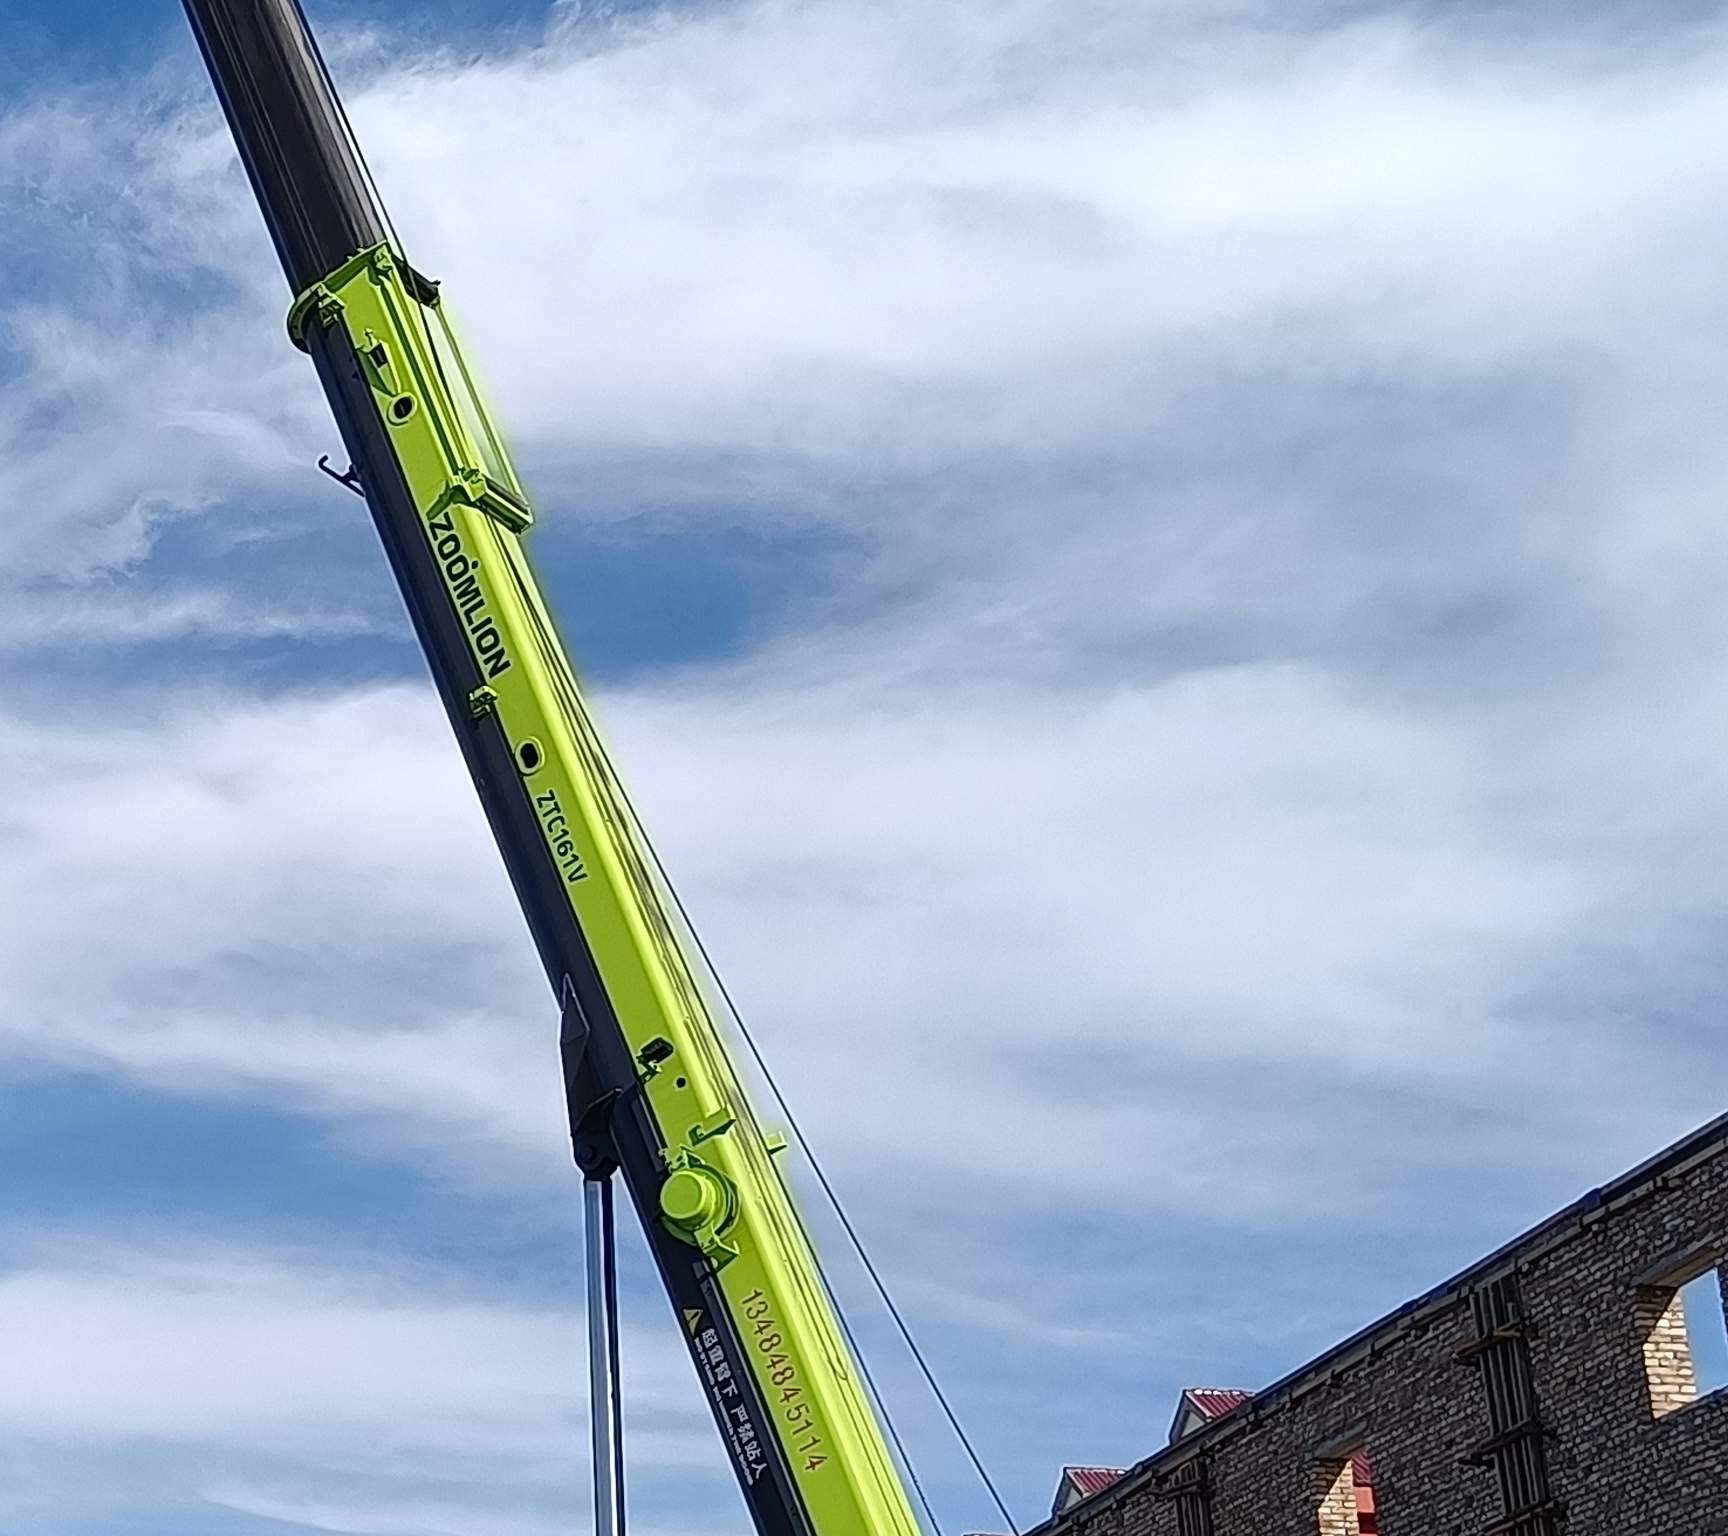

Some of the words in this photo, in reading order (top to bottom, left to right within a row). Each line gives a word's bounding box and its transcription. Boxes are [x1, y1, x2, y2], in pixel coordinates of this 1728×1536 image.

[428, 512, 511, 678] ZOOMLION
[536, 788, 587, 884] ZTC161V
[742, 1289, 828, 1471] 13484845114
